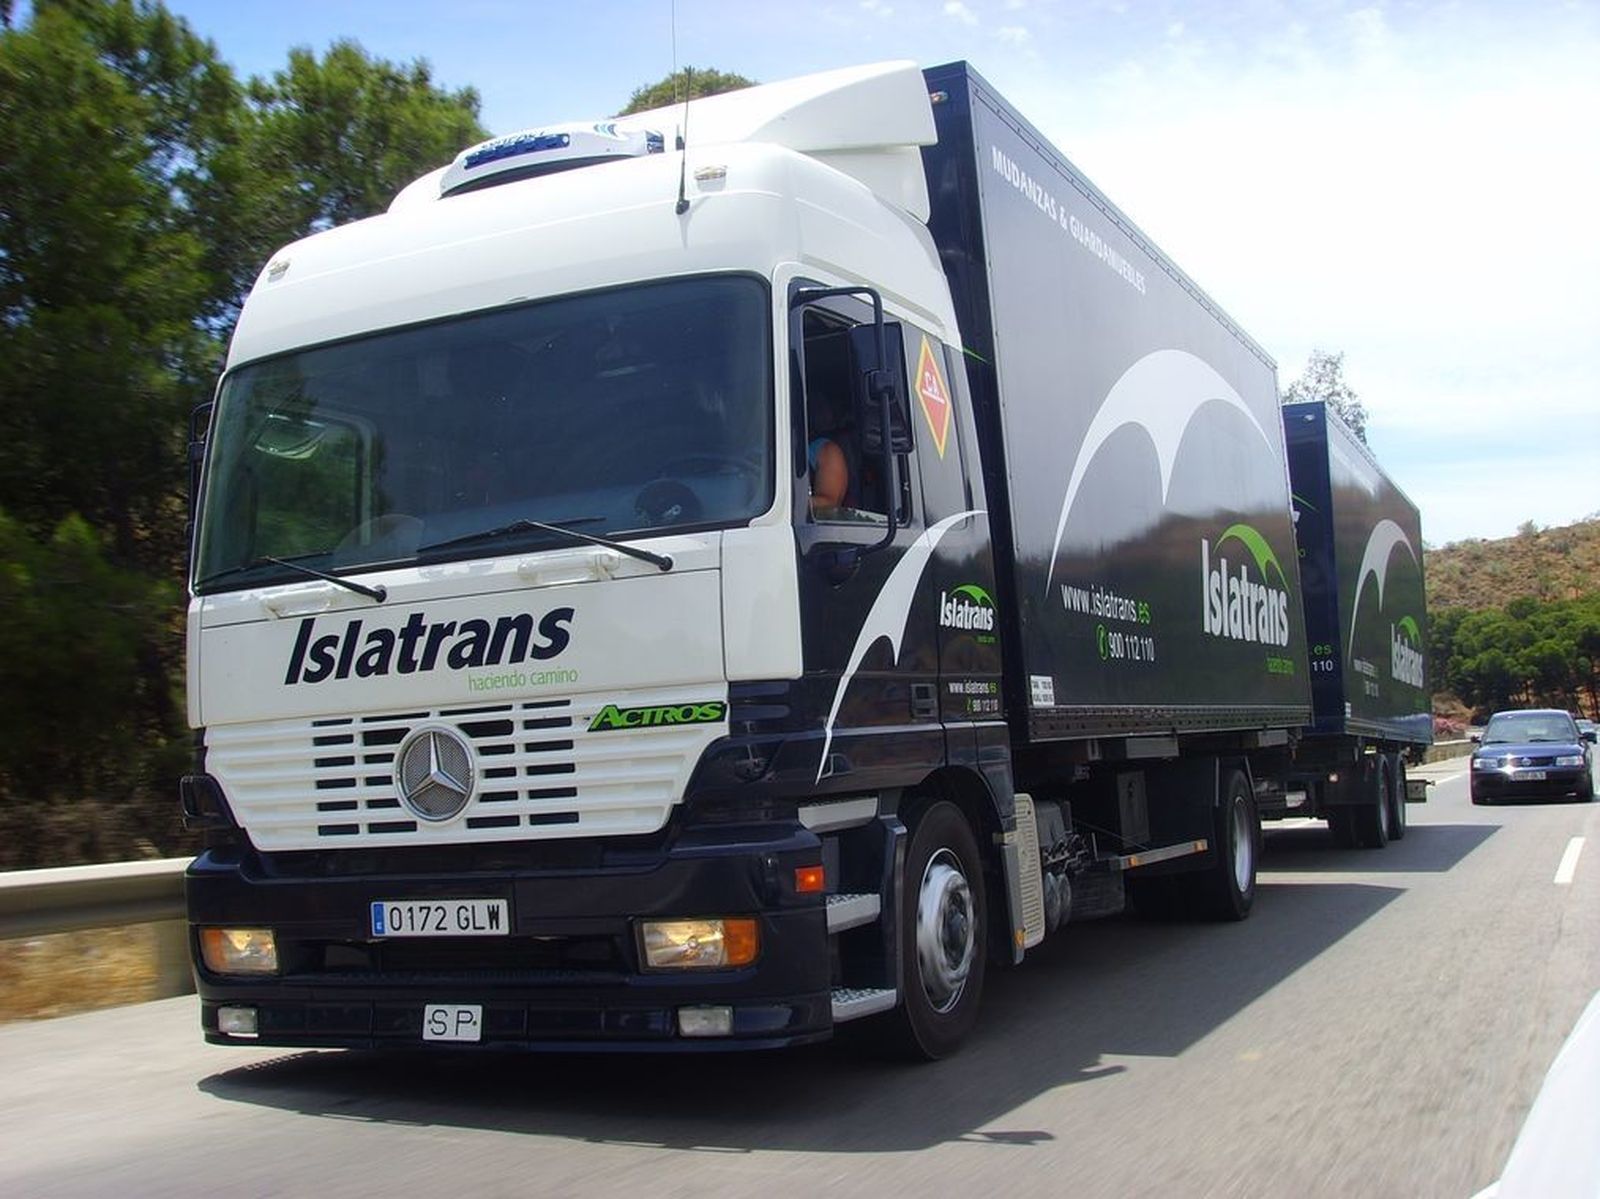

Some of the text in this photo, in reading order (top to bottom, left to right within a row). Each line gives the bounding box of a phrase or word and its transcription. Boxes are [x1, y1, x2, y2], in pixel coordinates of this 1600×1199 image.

[992, 146, 1057, 221] MUDANZAS
[1059, 206, 1068, 231] &
[1202, 538, 1289, 647] Islatrans
[940, 591, 994, 631] Islatrans
[284, 607, 575, 685] Islatrans
[1109, 631, 1155, 661] 900 112 110
[468, 667, 578, 692] haciendo camino
[1312, 660, 1333, 671] 110
[390, 905, 500, 932] 0172 GLW
